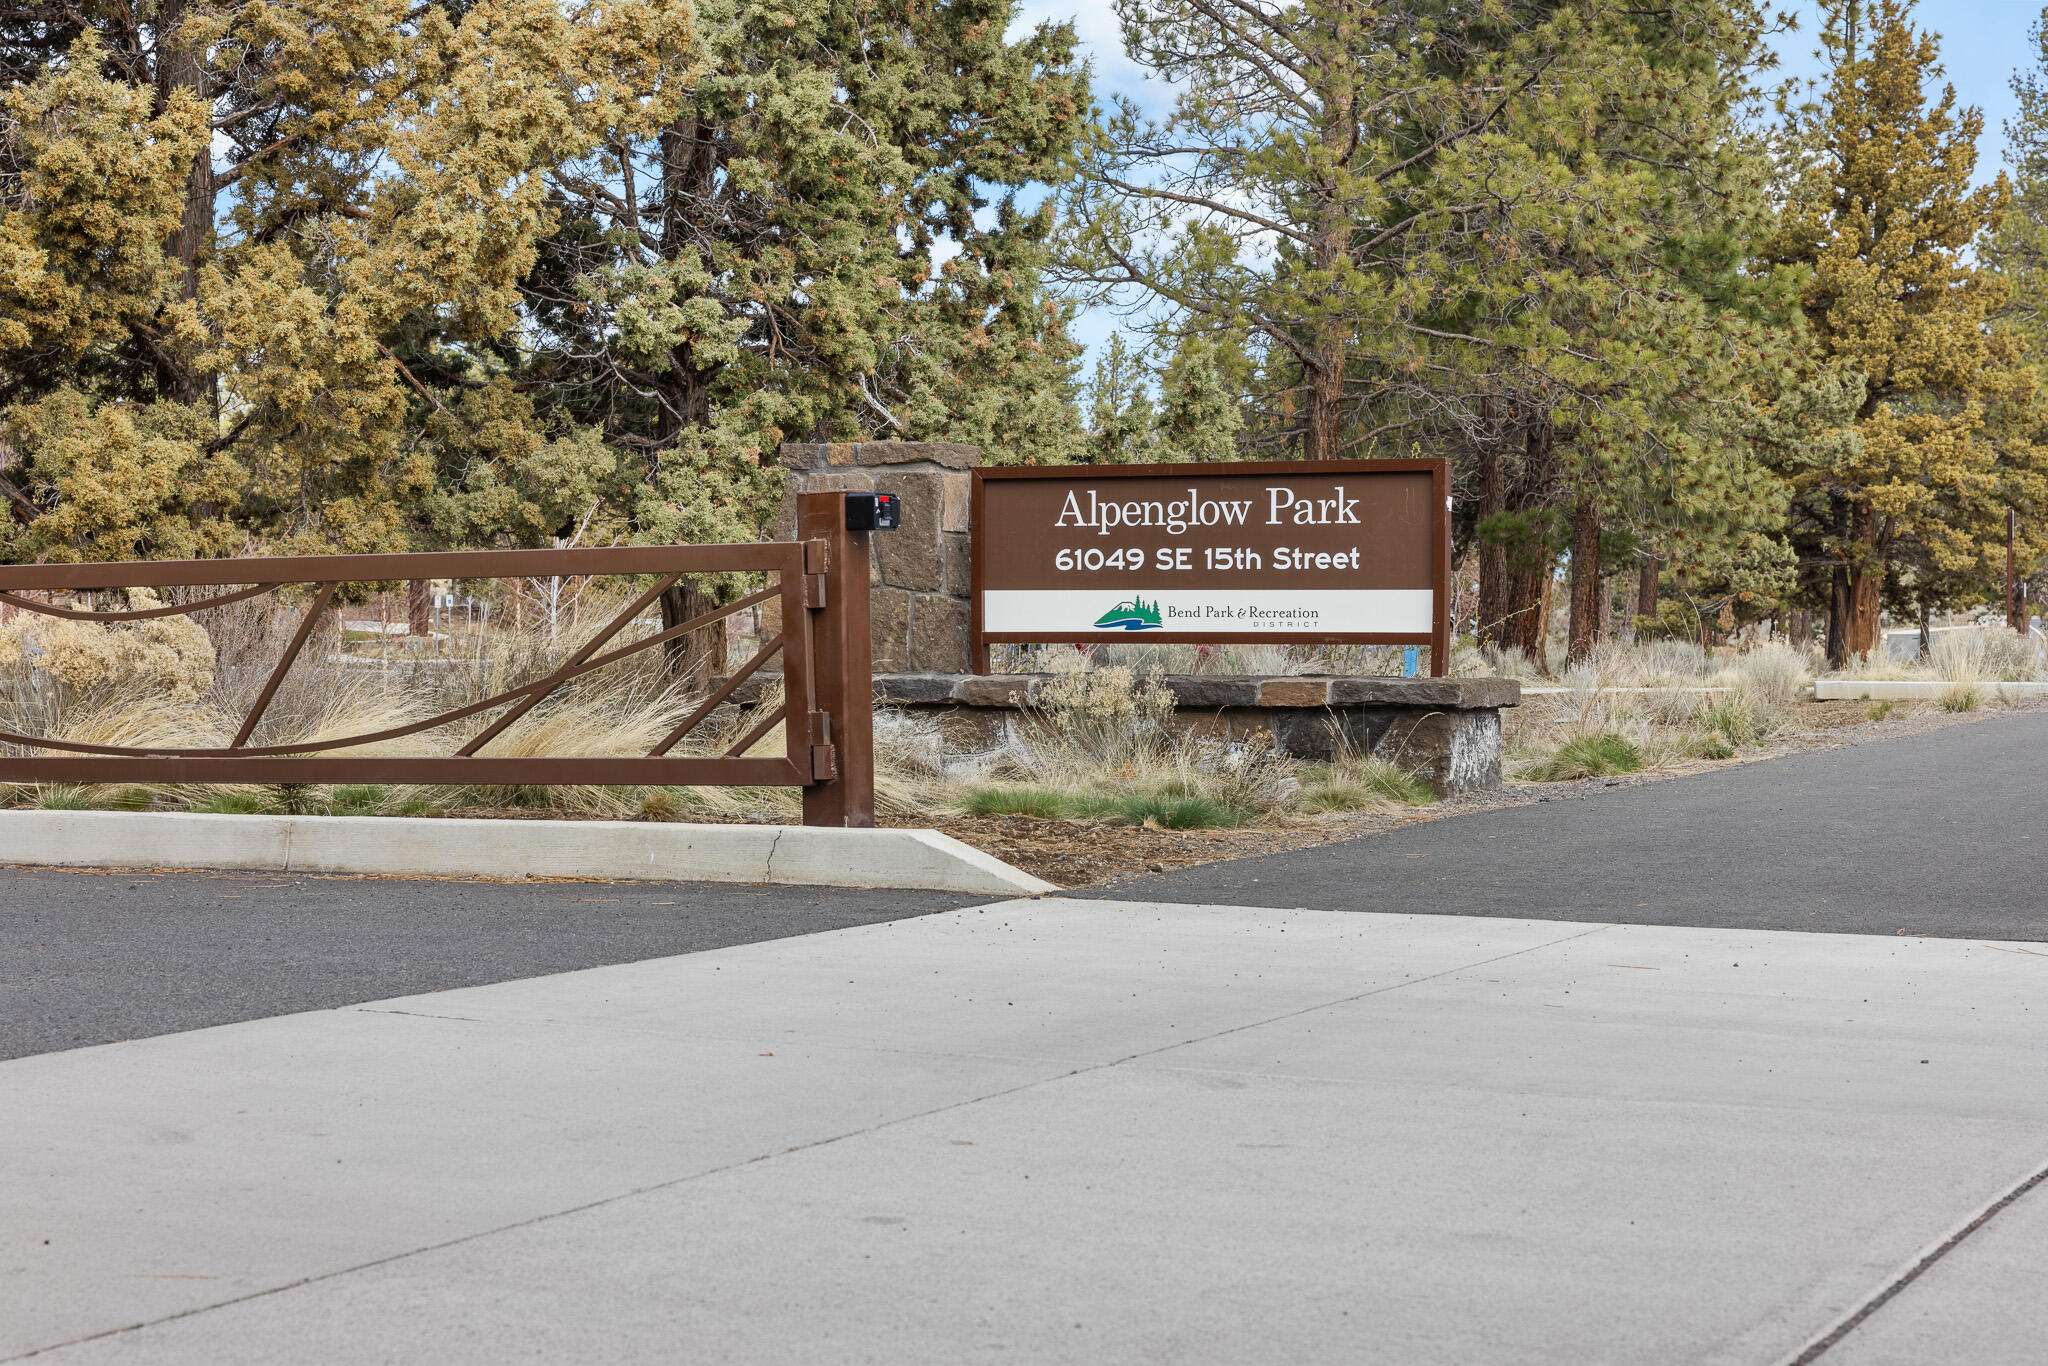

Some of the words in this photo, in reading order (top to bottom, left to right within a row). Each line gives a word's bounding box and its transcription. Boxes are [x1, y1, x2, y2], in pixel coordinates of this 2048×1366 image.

[1054, 488, 1253, 536] Alpenglow
[1265, 486, 1362, 525] Park
[1055, 547, 1145, 571] 61049
[1155, 547, 1193, 571] SE
[1204, 547, 1262, 570] 15th
[1272, 546, 1360, 570] Street
[1167, 605, 1201, 618] Bend
[1205, 605, 1234, 618] Park
[1237, 607, 1247, 620] &
[1249, 605, 1319, 619] Recreation
